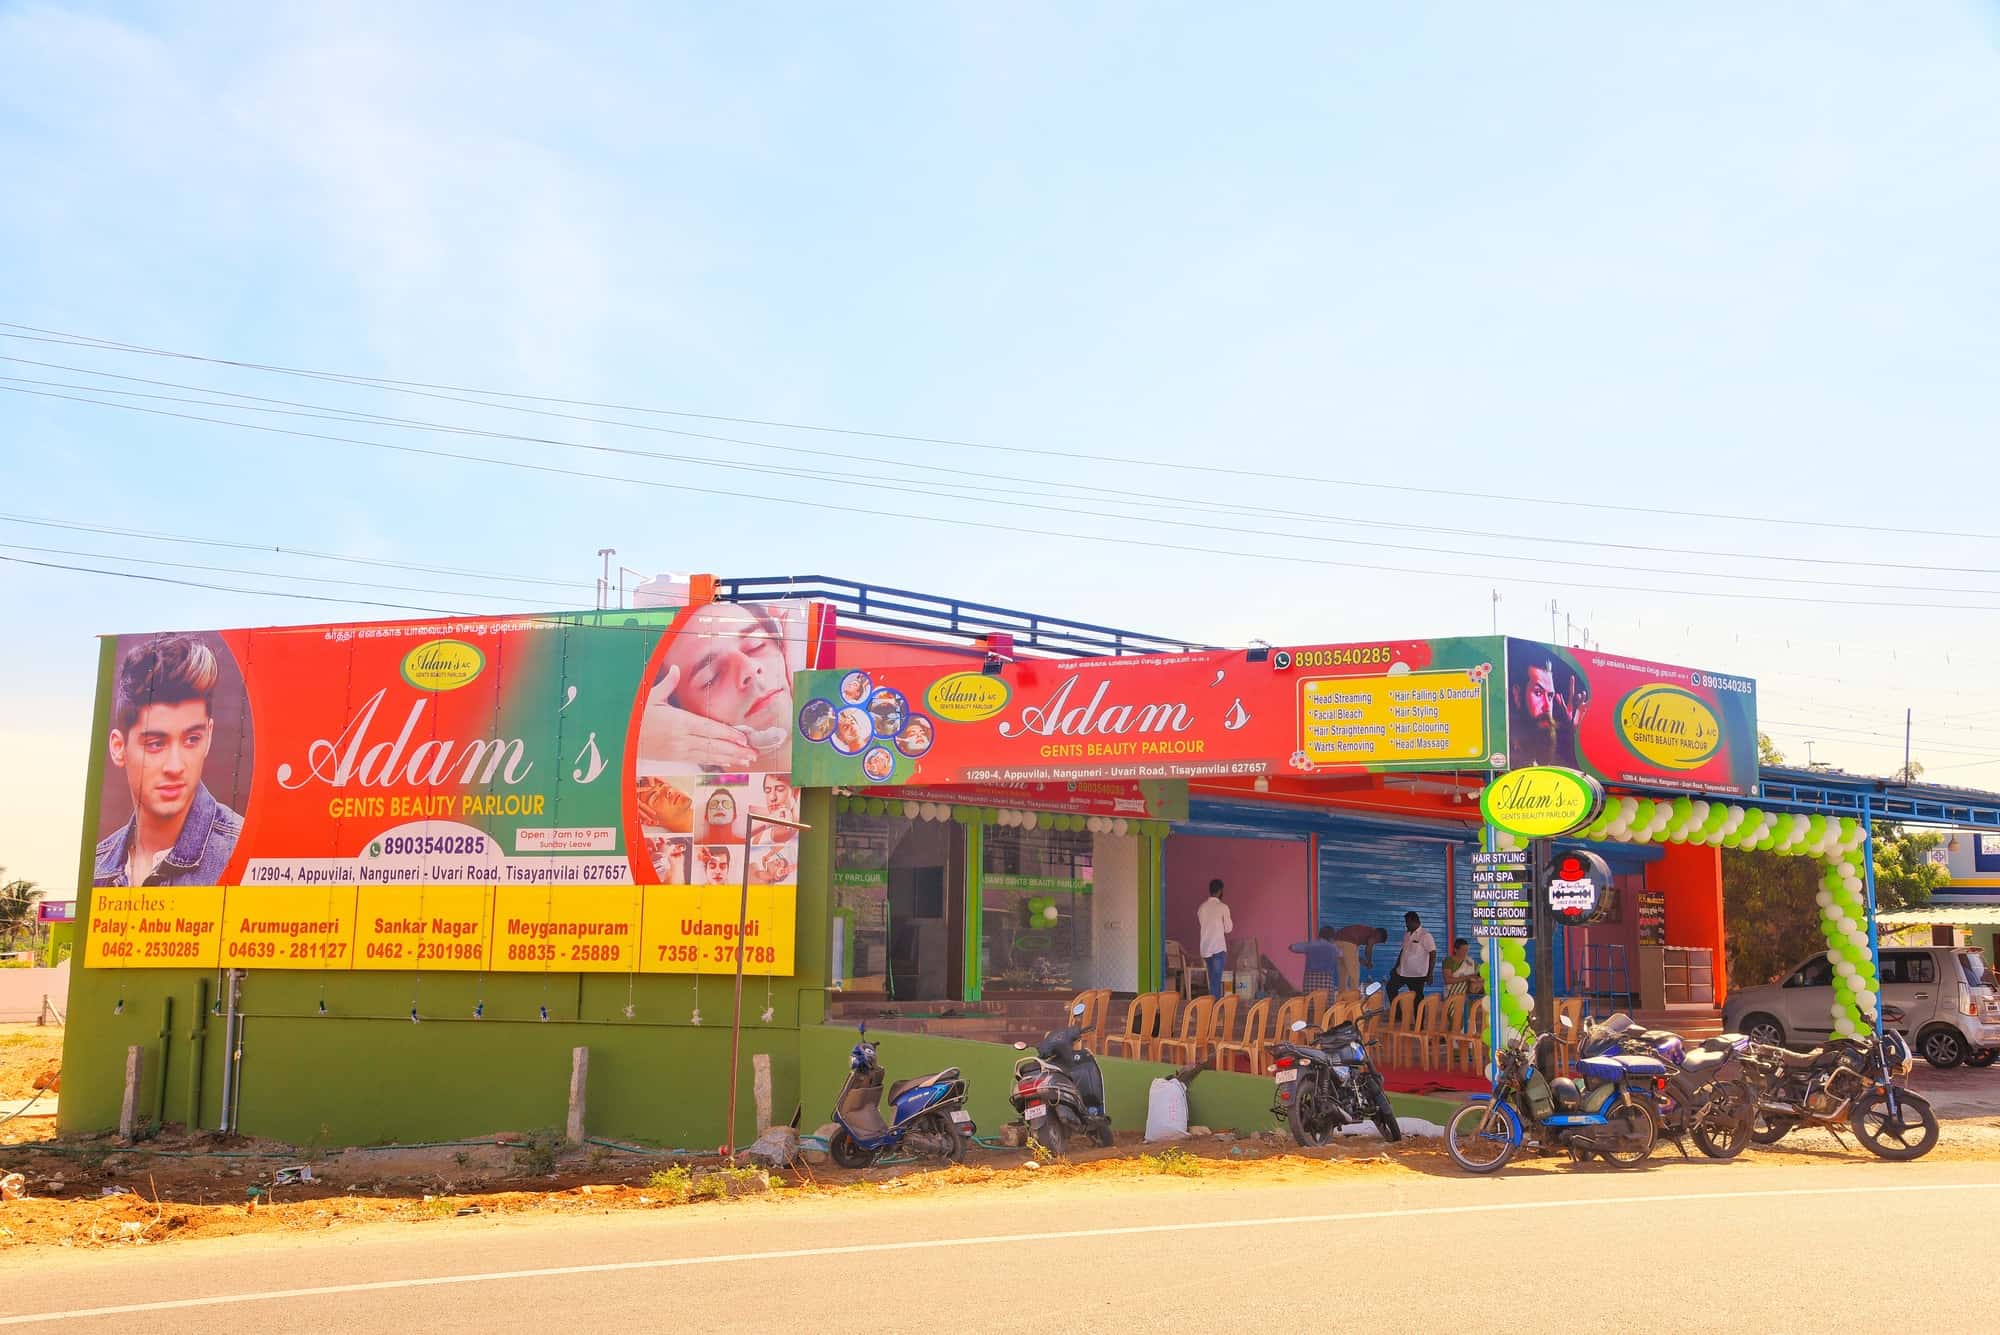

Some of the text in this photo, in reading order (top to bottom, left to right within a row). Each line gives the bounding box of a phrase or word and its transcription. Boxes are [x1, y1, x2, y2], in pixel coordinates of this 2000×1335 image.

[411, 649, 460, 670] Adam's
[1295, 647, 1391, 667] 8903540285
[935, 681, 985, 702] Adam's
[1702, 675, 1752, 694] 8903540285
[1314, 693, 1372, 704] Head Streaming
[1395, 688, 1480, 702] Hair Falling & Dandruff
[1314, 709, 1363, 720] Facial Bleach
[1395, 706, 1438, 718] Hair Styling
[1314, 726, 1329, 736] Hair
[1395, 722, 1449, 733] Hair Colouring
[1040, 740, 1205, 758] GENTS BEAUTY PARLOUR
[1314, 741, 1374, 752] Warts Removing
[1396, 738, 1449, 750] Head Massage
[1634, 733, 1707, 750] GENTS BEAUTY PARLOUR
[1053, 768, 1102, 779] Nanguneri
[1111, 767, 1136, 777] Uvari
[1139, 765, 1167, 777] Road,
[1170, 763, 1229, 776] Tisayanvilai
[1232, 762, 1267, 773] 627657
[1497, 775, 1563, 809] Adam's
[329, 794, 545, 818] GENTS BEAUTY PARLOUR
[1501, 810, 1576, 820] GENTS BEAUTY PARLOUR
[520, 831, 545, 840] Open
[552, 830, 572, 839] 7am
[586, 830, 592, 838] 9
[384, 836, 485, 855] 8903540285
[540, 841, 566, 849] Sunday
[1472, 853, 1526, 864] HAIR STYLING
[298, 867, 355, 884] Appuvilai,
[360, 866, 420, 883] Nanguneri
[432, 865, 462, 881] Uvari
[505, 865, 580, 883] Tisayanvilai
[583, 865, 627, 880] 627657
[1473, 872, 1513, 882] HAIR SPA
[98, 894, 166, 911] Branches
[1473, 890, 1519, 900] MANICURE
[1473, 908, 1526, 918] BRIDE GROOM
[93, 919, 127, 936] Palay
[139, 918, 171, 933] Anbu
[175, 918, 214, 936] Nagar
[240, 918, 339, 937] Arumuganeri
[374, 918, 478, 938] Sankar Nagar
[508, 919, 628, 939] Meyganapuram
[1473, 926, 1527, 936] HAIR COLOURING
[102, 942, 133, 957] 0462
[145, 942, 199, 958] 2530285
[229, 942, 275, 958] 04639
[289, 943, 347, 959] 281127
[367, 943, 402, 959] 0462
[417, 943, 482, 960] 2301986
[508, 945, 555, 961] 88835
[571, 945, 620, 961] 25889
[658, 945, 698, 962] 7358
